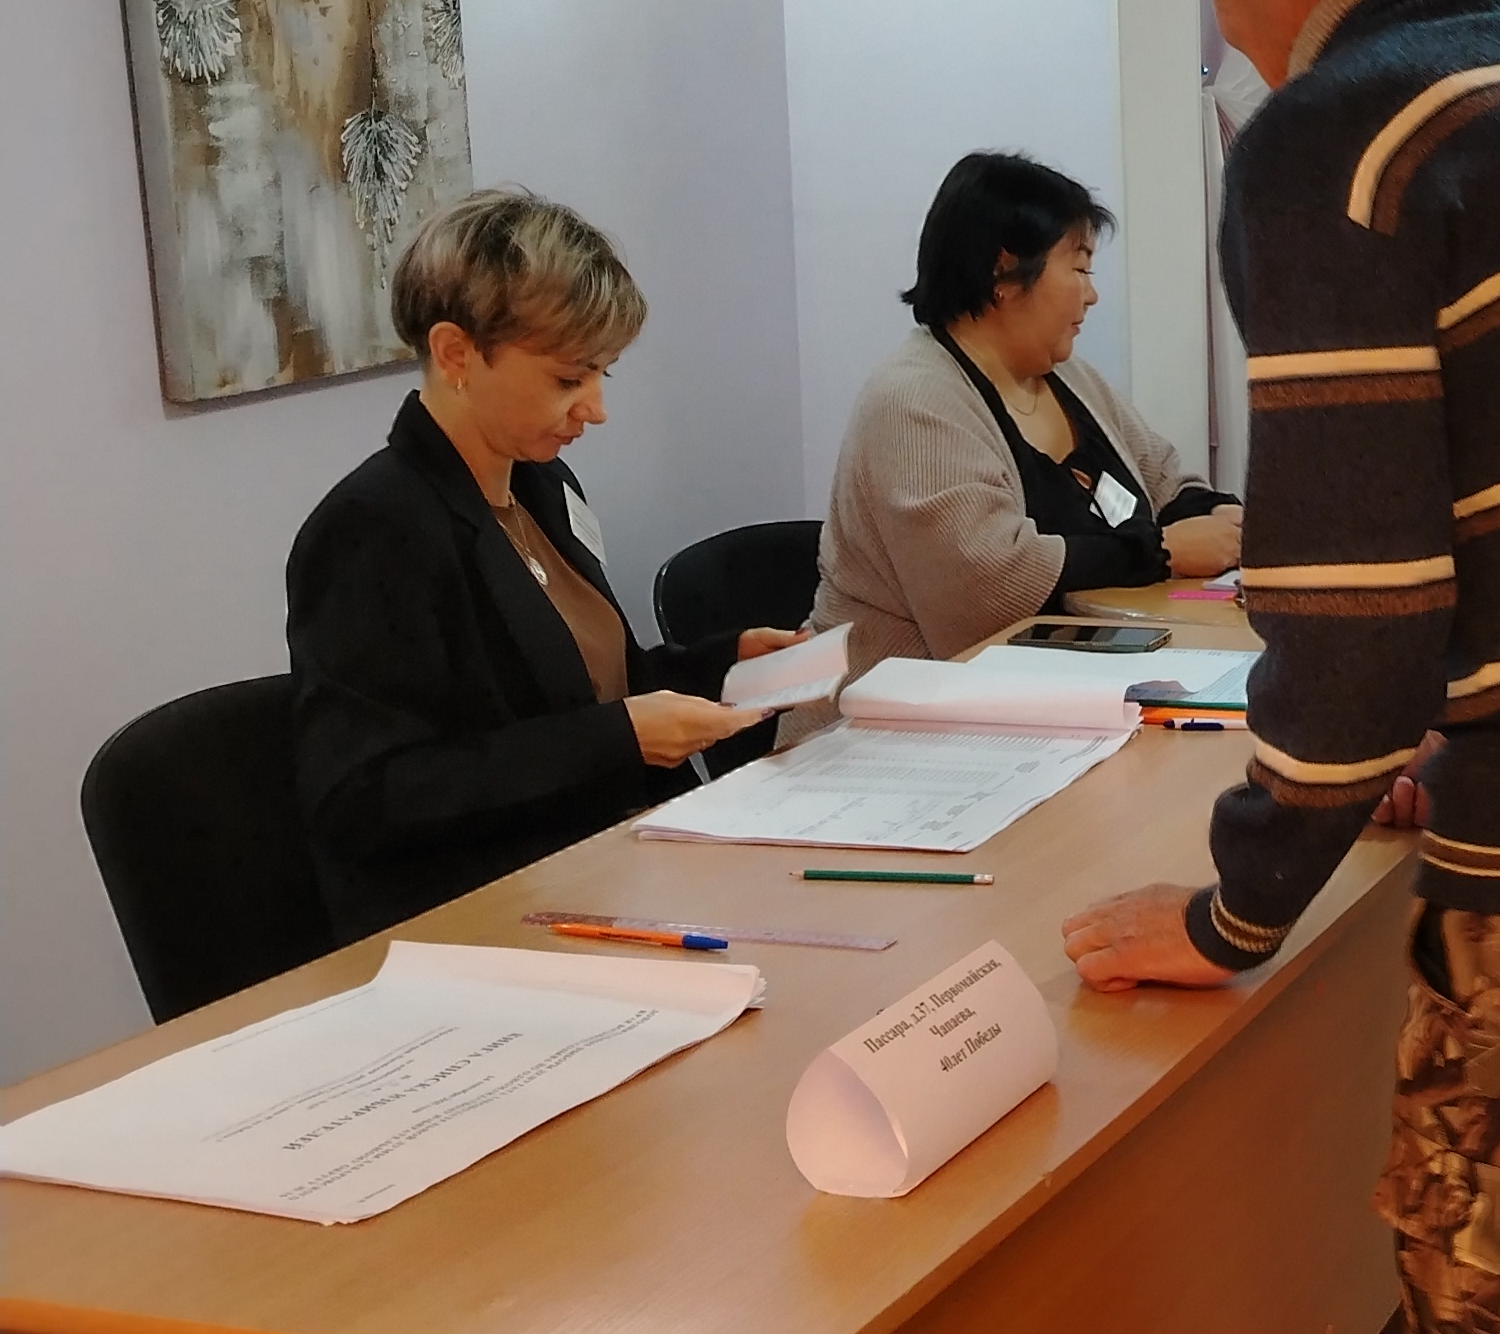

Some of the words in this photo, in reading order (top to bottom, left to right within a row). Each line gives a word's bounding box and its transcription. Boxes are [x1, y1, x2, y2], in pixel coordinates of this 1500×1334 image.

[928, 959, 1002, 1008] Первомайская,
[465, 1032, 524, 1059] КНИГА
[400, 1058, 474, 1093] СПИСКА
[281, 1092, 407, 1150] ИЗБИРАТЕЛЕЙ
